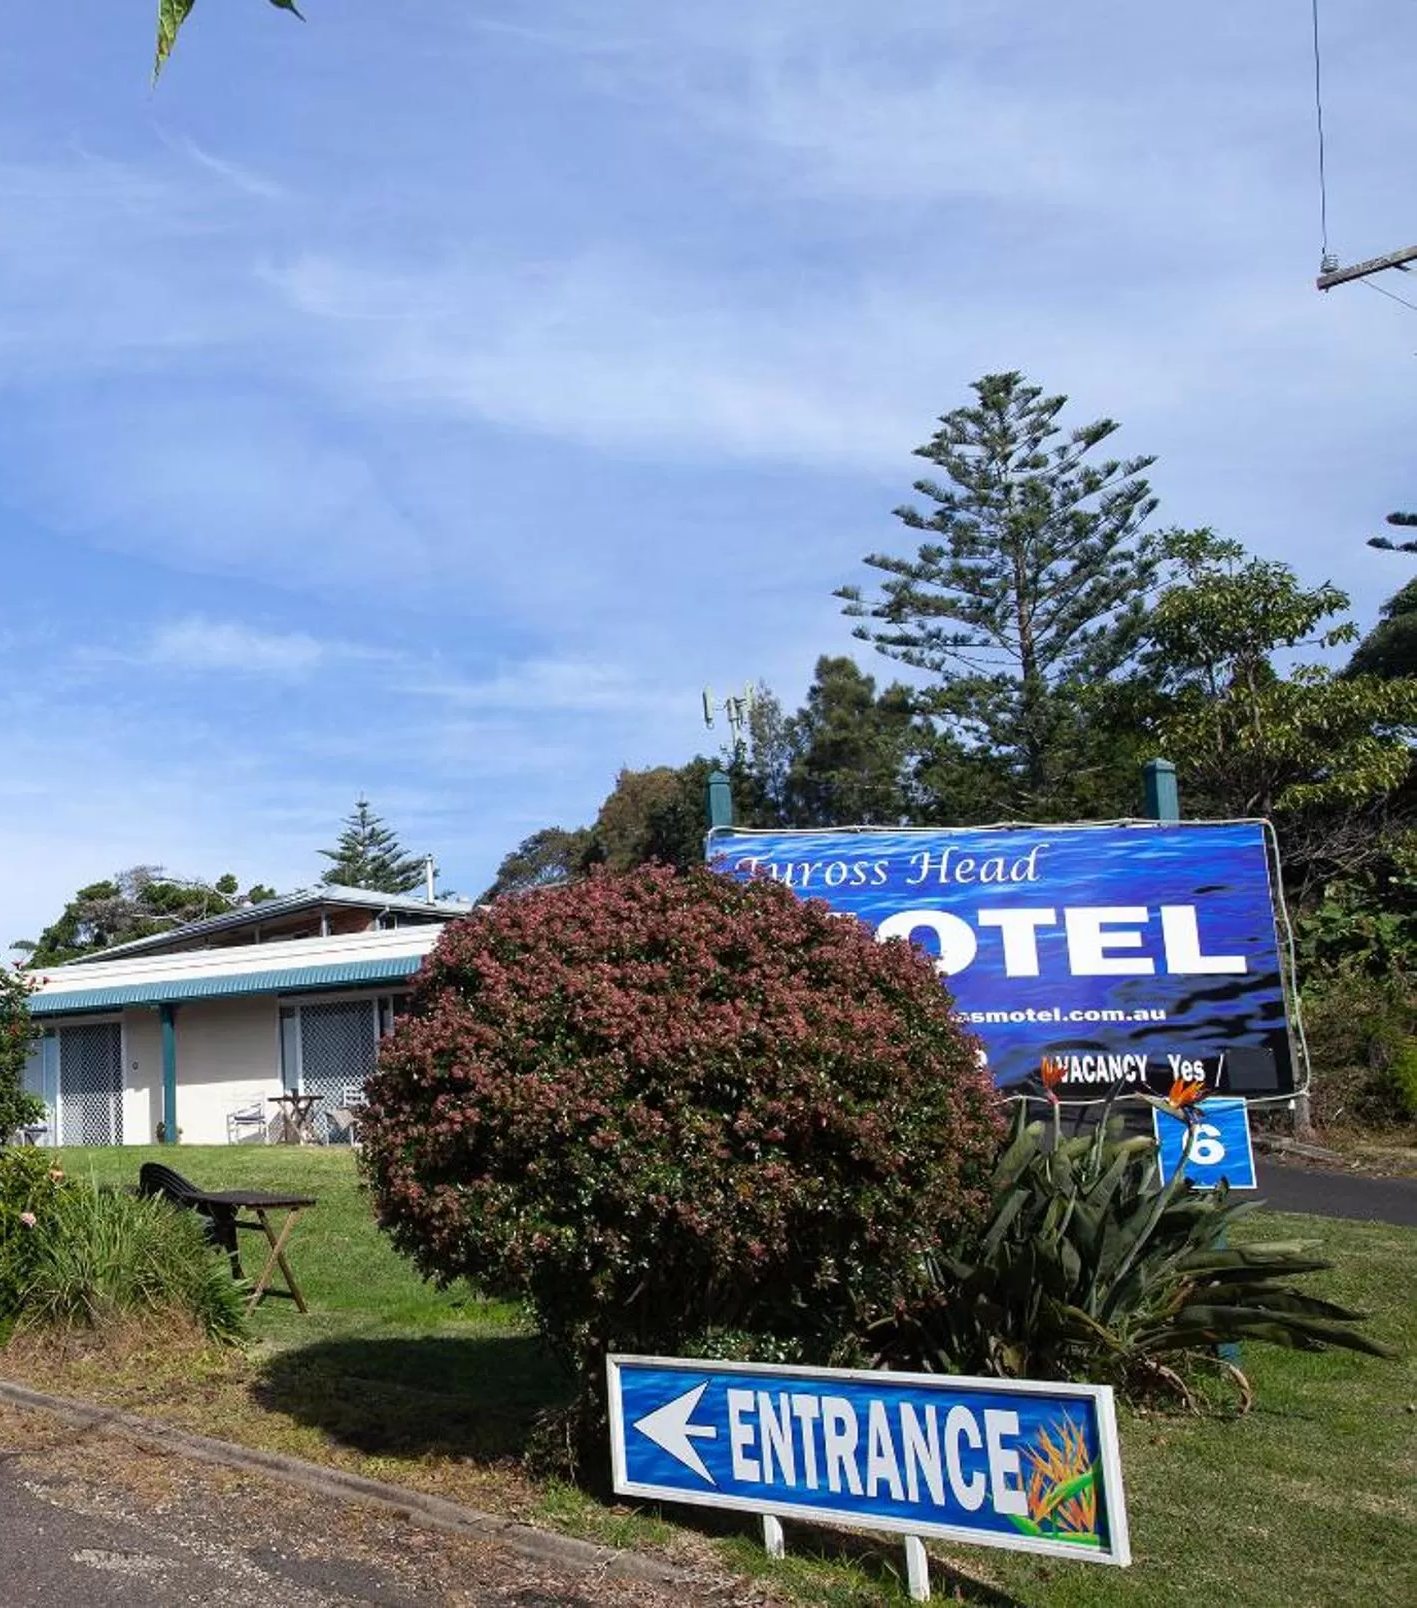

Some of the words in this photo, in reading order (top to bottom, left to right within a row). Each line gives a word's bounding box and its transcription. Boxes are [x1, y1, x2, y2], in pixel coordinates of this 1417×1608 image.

[734, 850, 889, 887] Tuross
[906, 843, 1050, 885] Head
[827, 903, 1248, 979] OTEL
[1055, 1054, 1148, 1083] VACANCY
[1167, 1054, 1206, 1082] Yes
[1182, 1123, 1226, 1165] 6
[726, 1387, 1030, 1517] ENTRANCE
